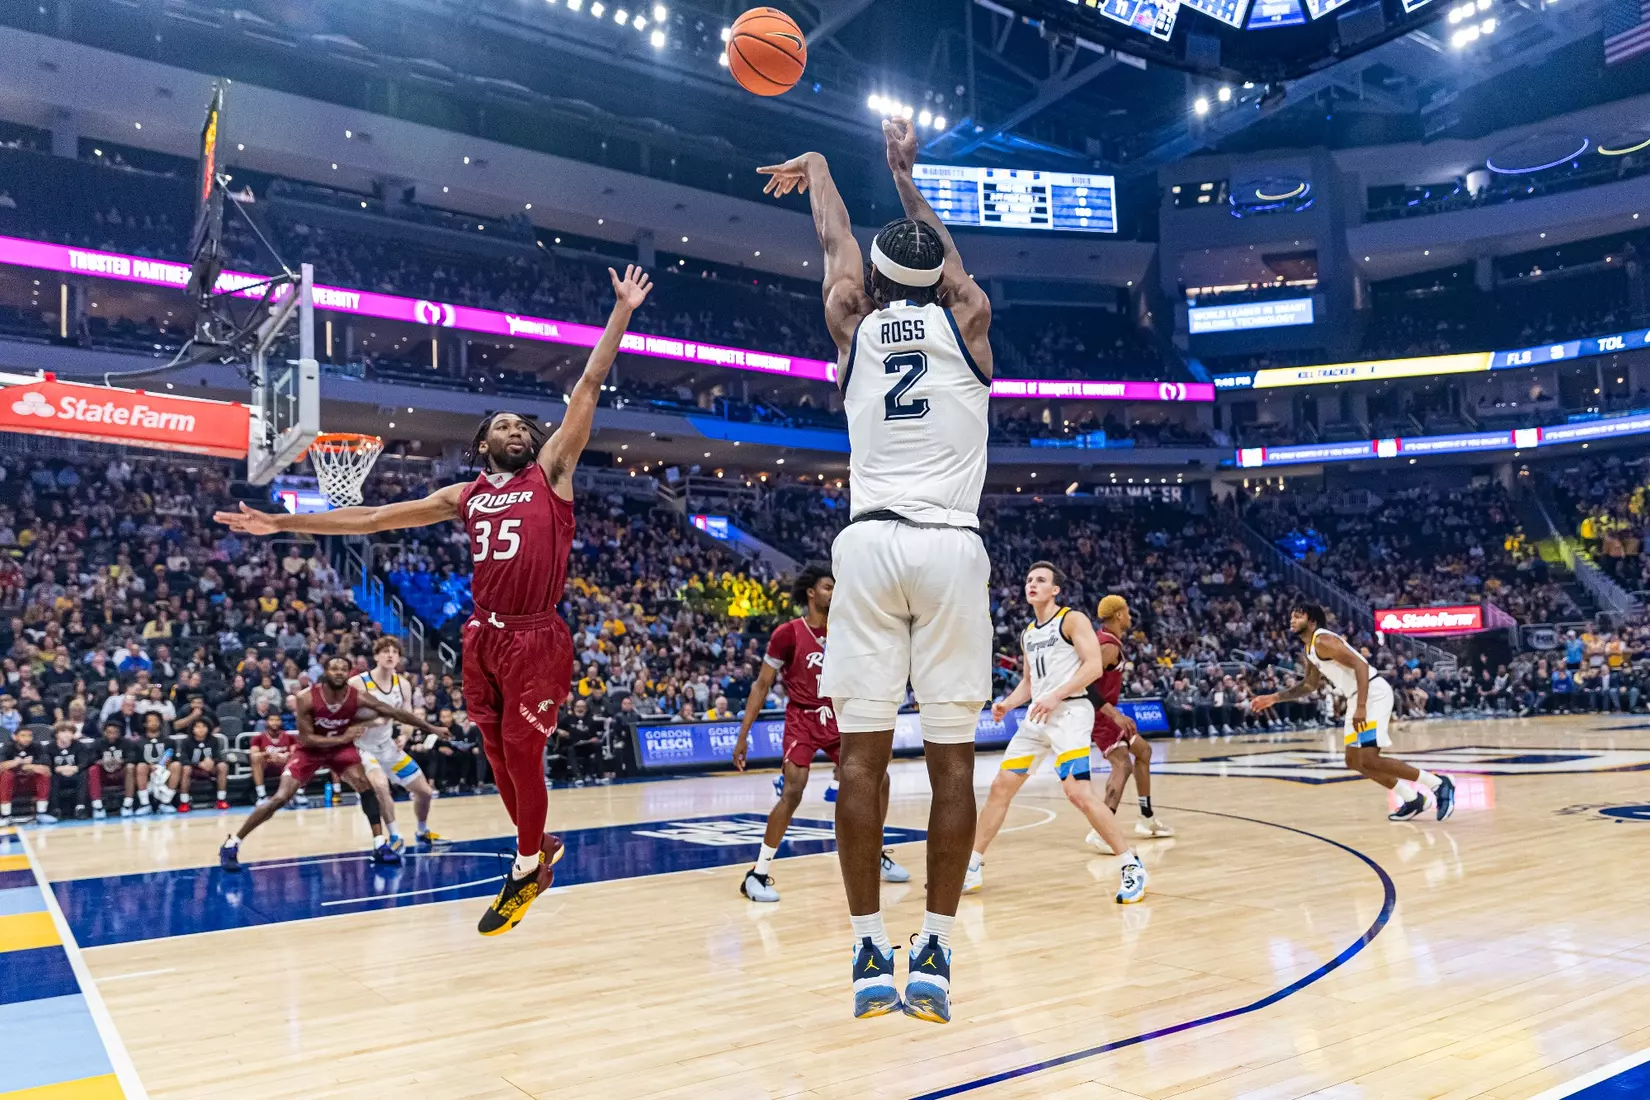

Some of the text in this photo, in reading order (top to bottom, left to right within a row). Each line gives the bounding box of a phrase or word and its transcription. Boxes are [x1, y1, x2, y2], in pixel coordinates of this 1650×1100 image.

[68, 249, 131, 276] TRUSTED
[133, 260, 192, 285] PARTNE
[881, 319, 925, 344] ROSS
[1598, 336, 1625, 351] TOL
[646, 337, 684, 357] PARTNER
[684, 343, 697, 358] OF
[1507, 350, 1532, 365] FLS
[883, 350, 931, 421] 2
[467, 491, 534, 519] RIDER
[473, 519, 521, 562] 35
[1036, 655, 1046, 679] 11
[645, 729, 692, 739] GORDON
[646, 738, 693, 750] FLESCH
